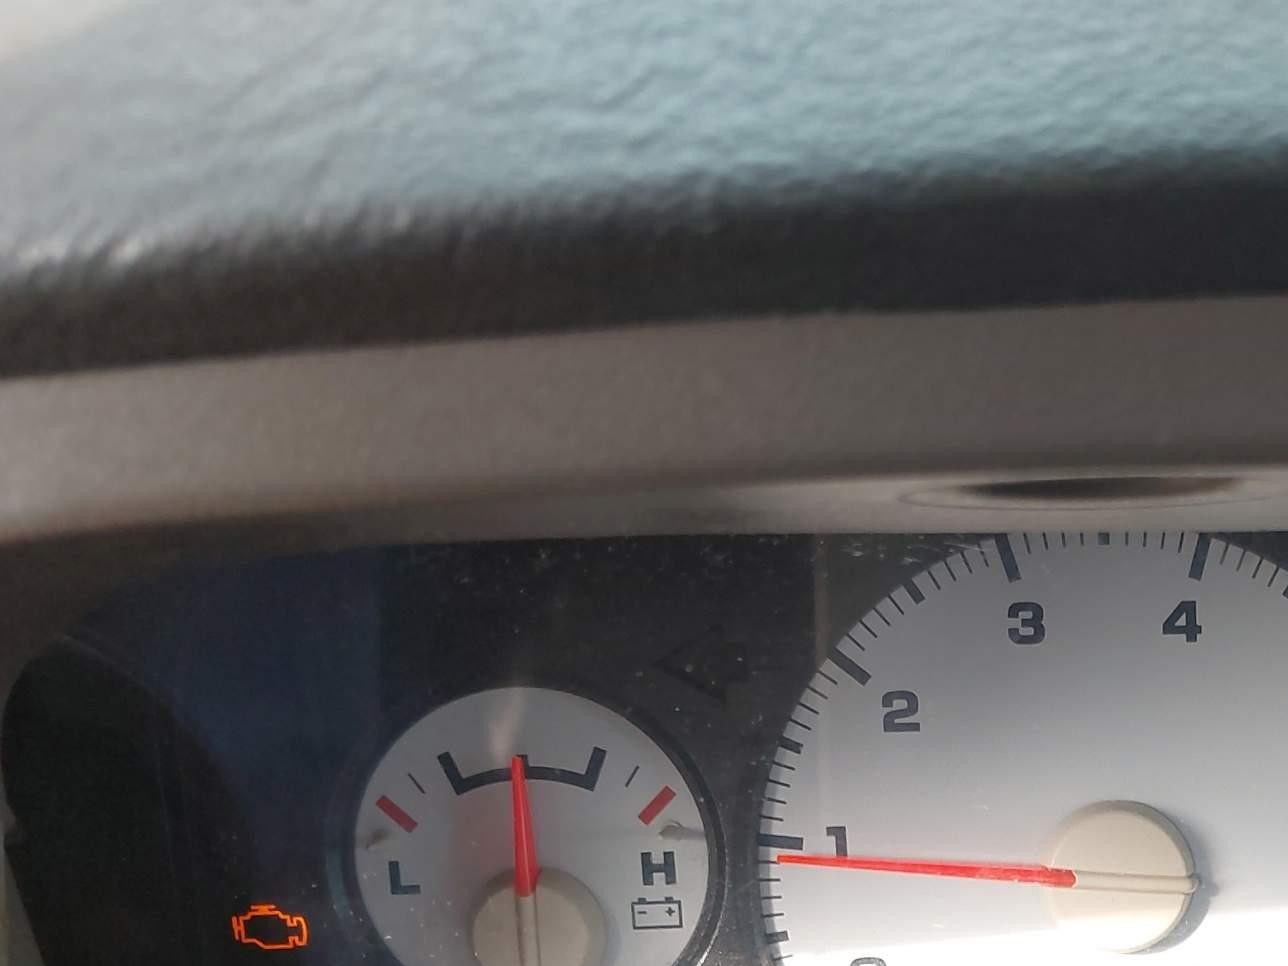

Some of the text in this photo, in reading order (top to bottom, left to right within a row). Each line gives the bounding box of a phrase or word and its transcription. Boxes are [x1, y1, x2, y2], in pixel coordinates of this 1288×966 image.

[1007, 601, 1045, 644] 3
[1162, 601, 1201, 642] 4
[882, 691, 920, 732] 2
[826, 826, 848, 857] 1
[389, 861, 420, 894] L
[641, 851, 676, 884] H
